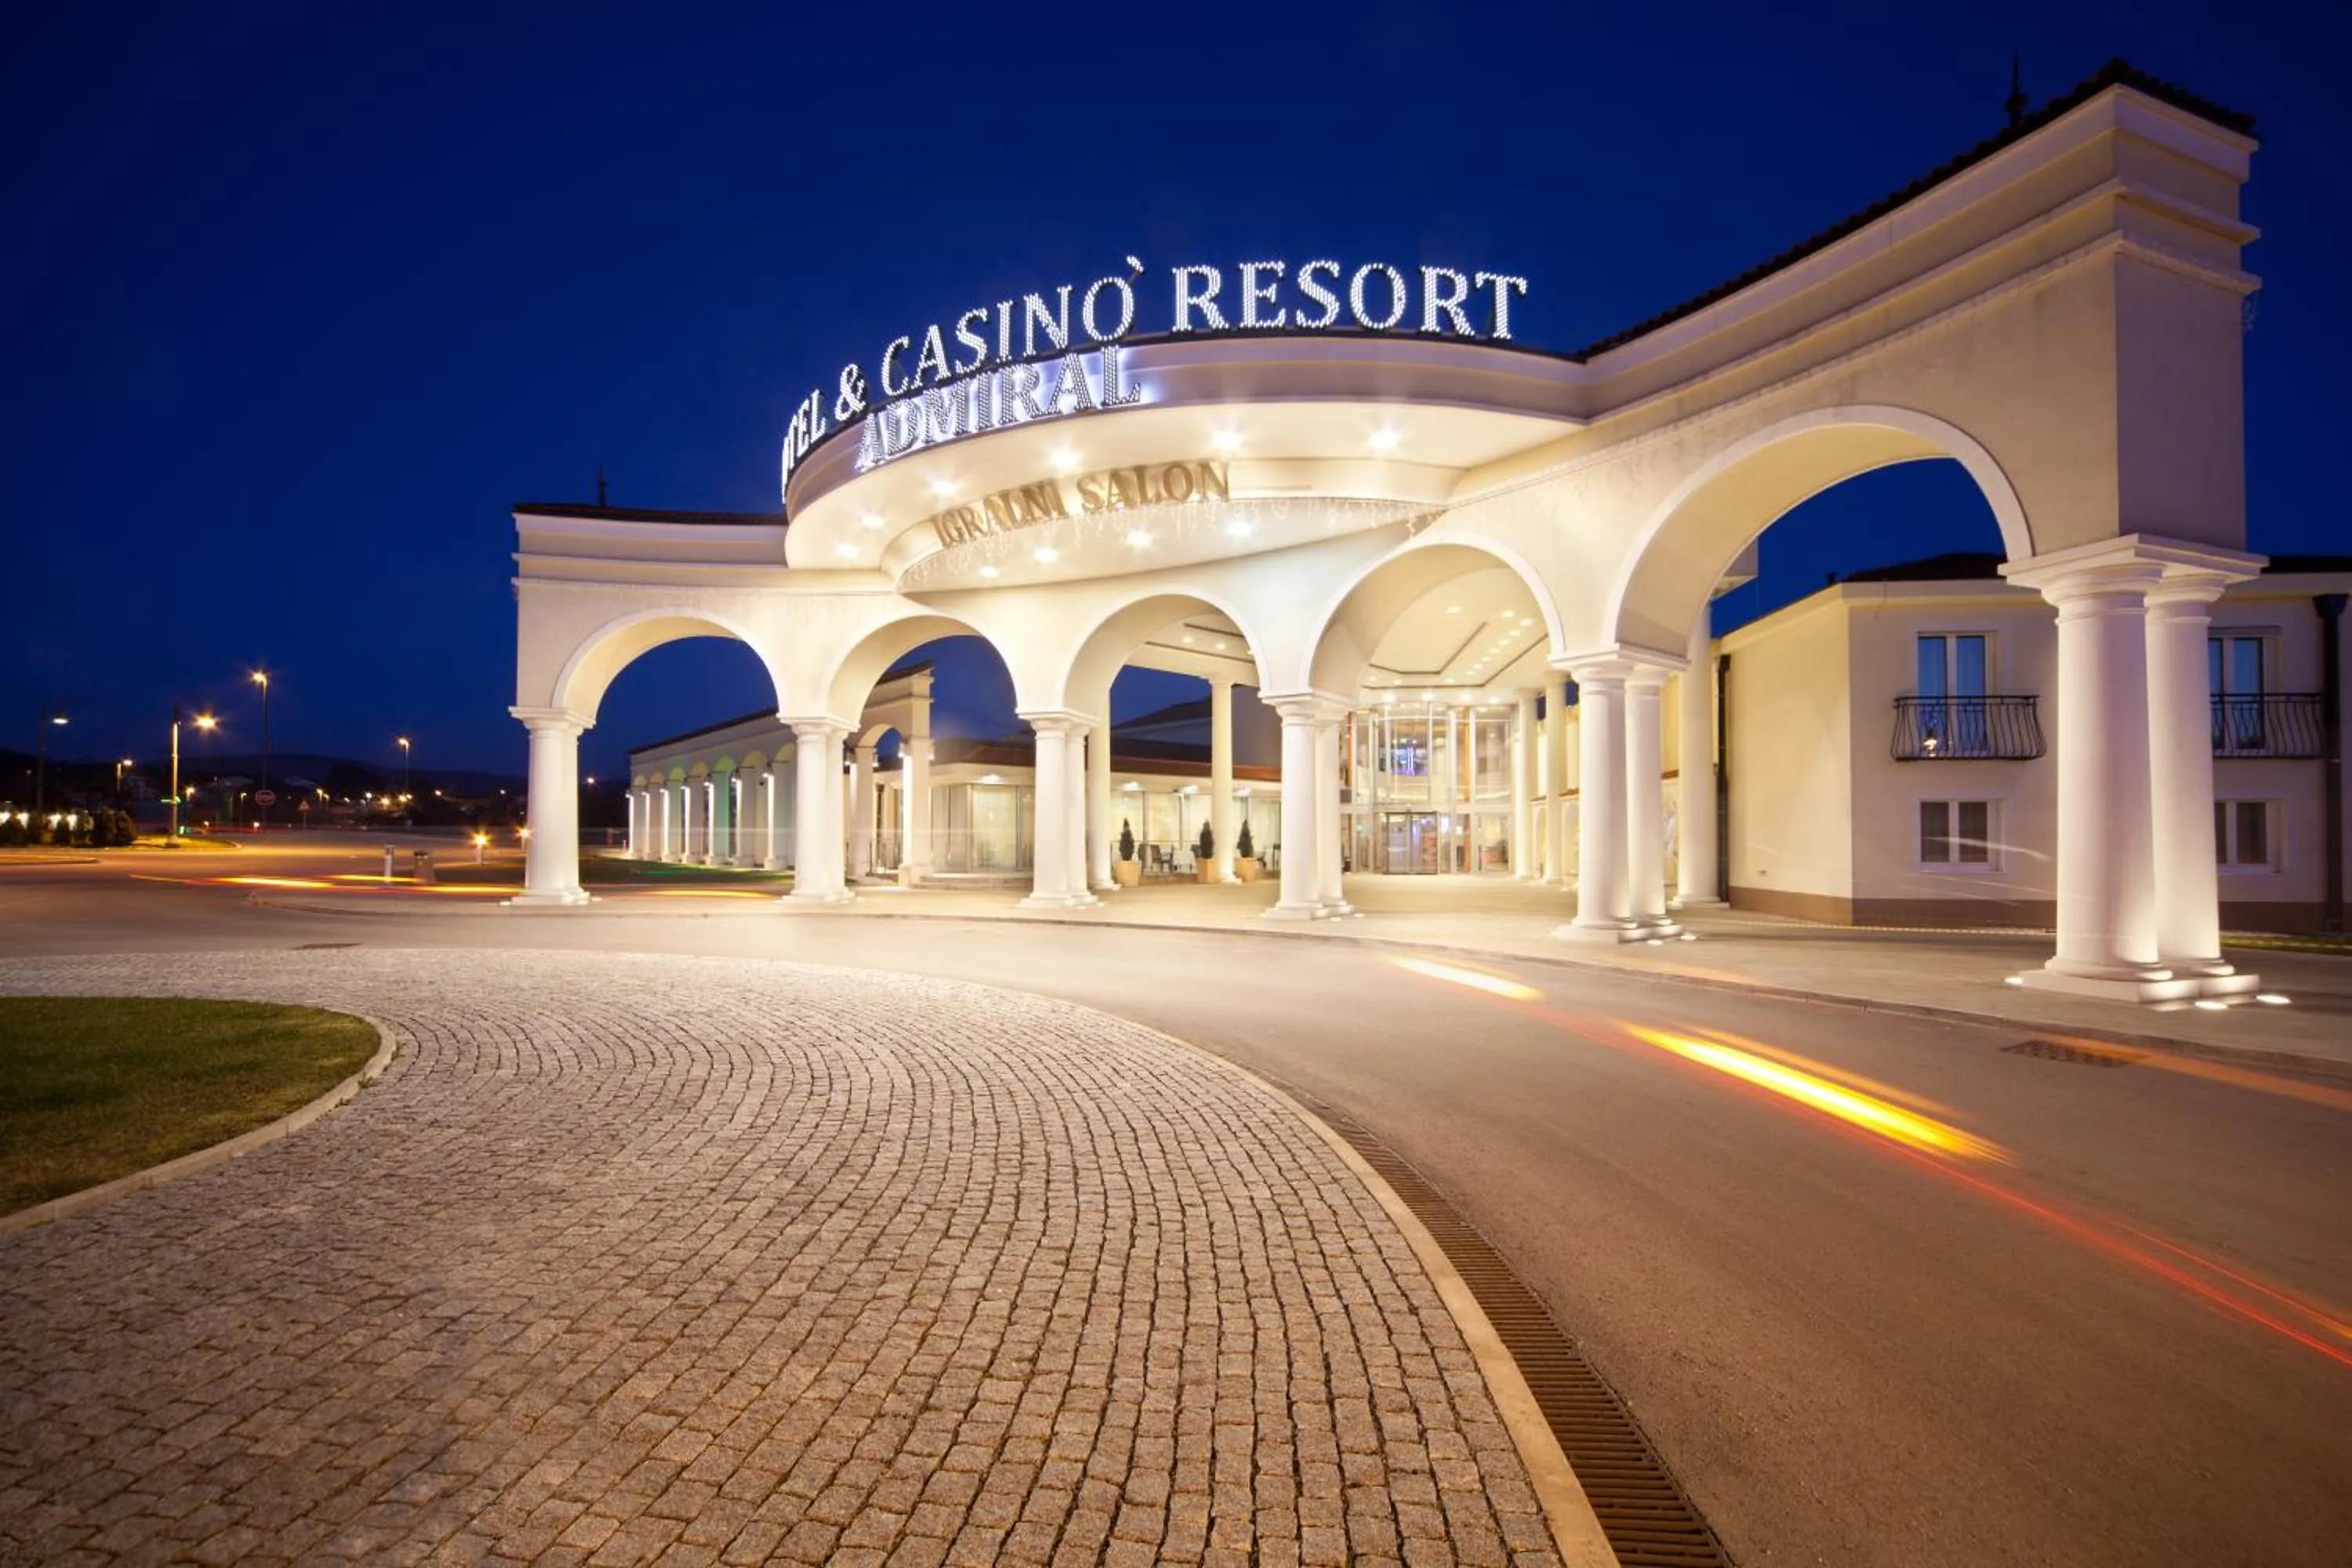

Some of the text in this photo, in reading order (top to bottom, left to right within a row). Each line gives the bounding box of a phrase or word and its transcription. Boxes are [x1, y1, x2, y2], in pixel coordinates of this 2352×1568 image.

[782, 389, 826, 504] TEL
[834, 363, 866, 422] &
[1171, 259, 1528, 341] RESORT
[854, 345, 1142, 472] ADMIRAL
[1076, 459, 1230, 515] SALON
